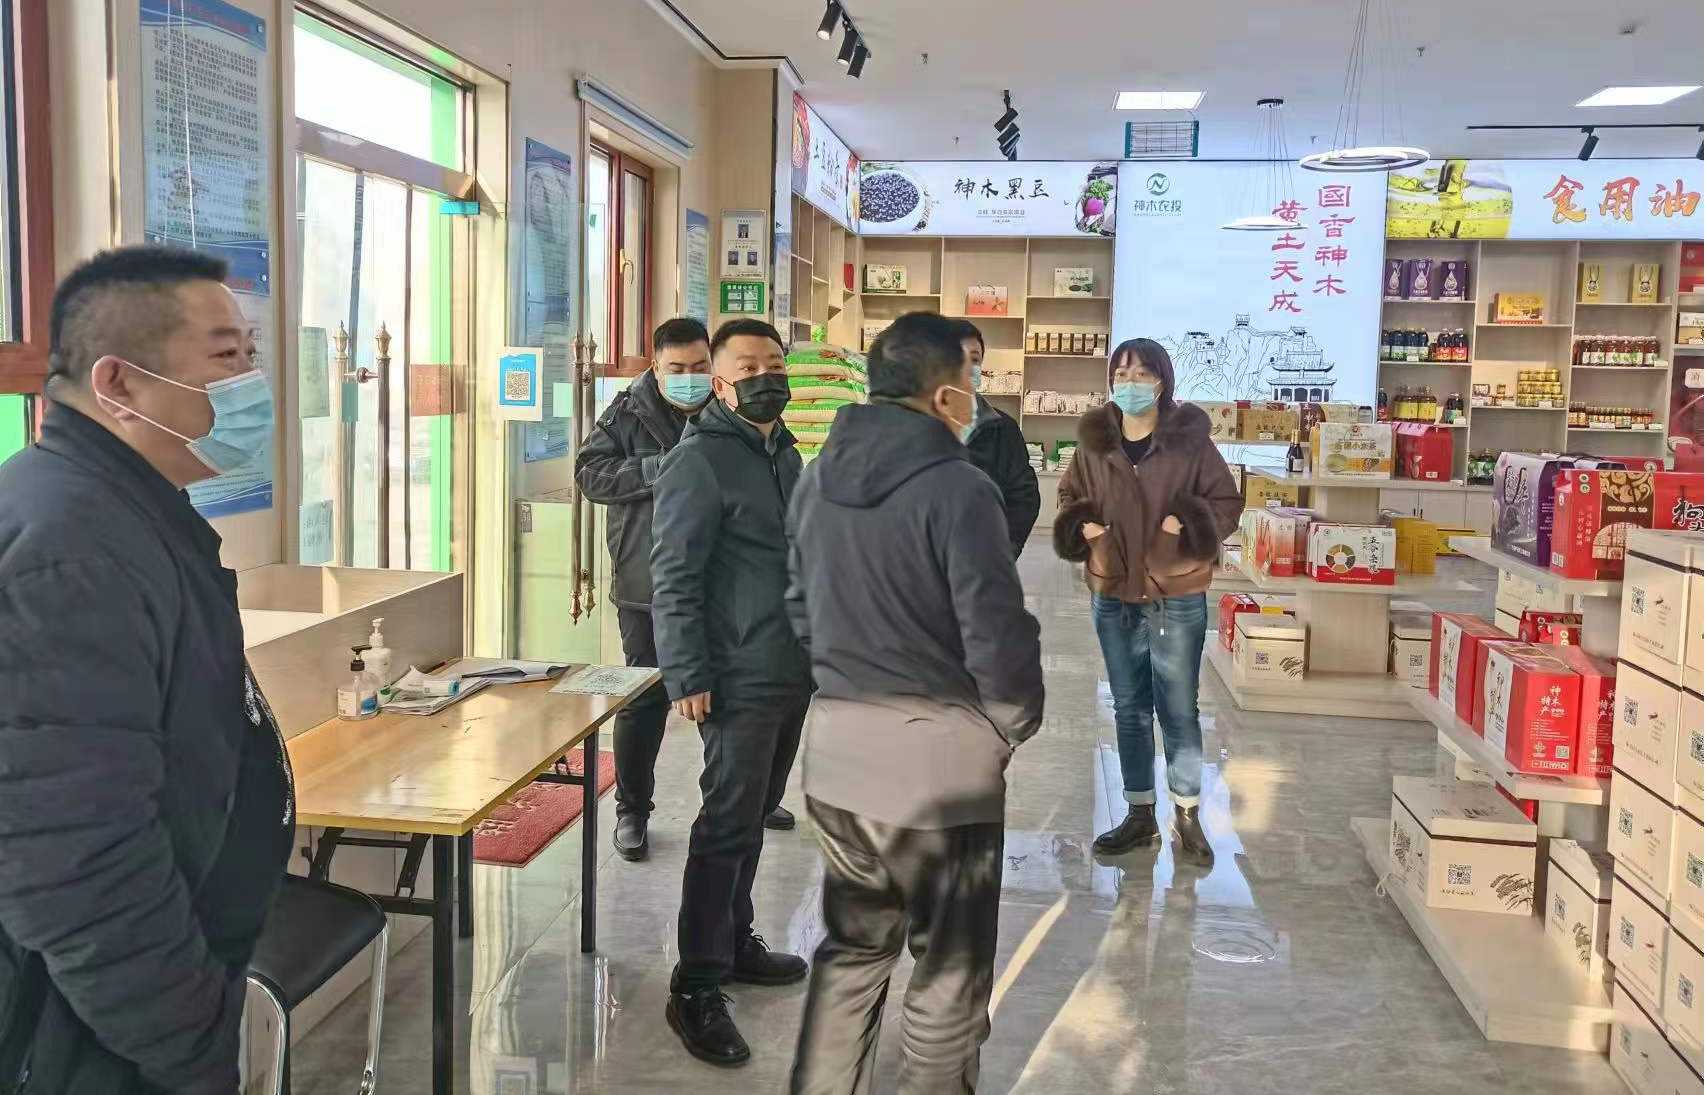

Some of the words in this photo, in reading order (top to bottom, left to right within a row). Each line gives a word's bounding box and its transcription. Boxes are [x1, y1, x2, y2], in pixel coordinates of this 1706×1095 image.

[954, 177, 1050, 200] 神木黑豆
[1133, 199, 1182, 212] 神木农投
[1542, 174, 1701, 224] 食用油
[1268, 200, 1308, 313] 黄土天成
